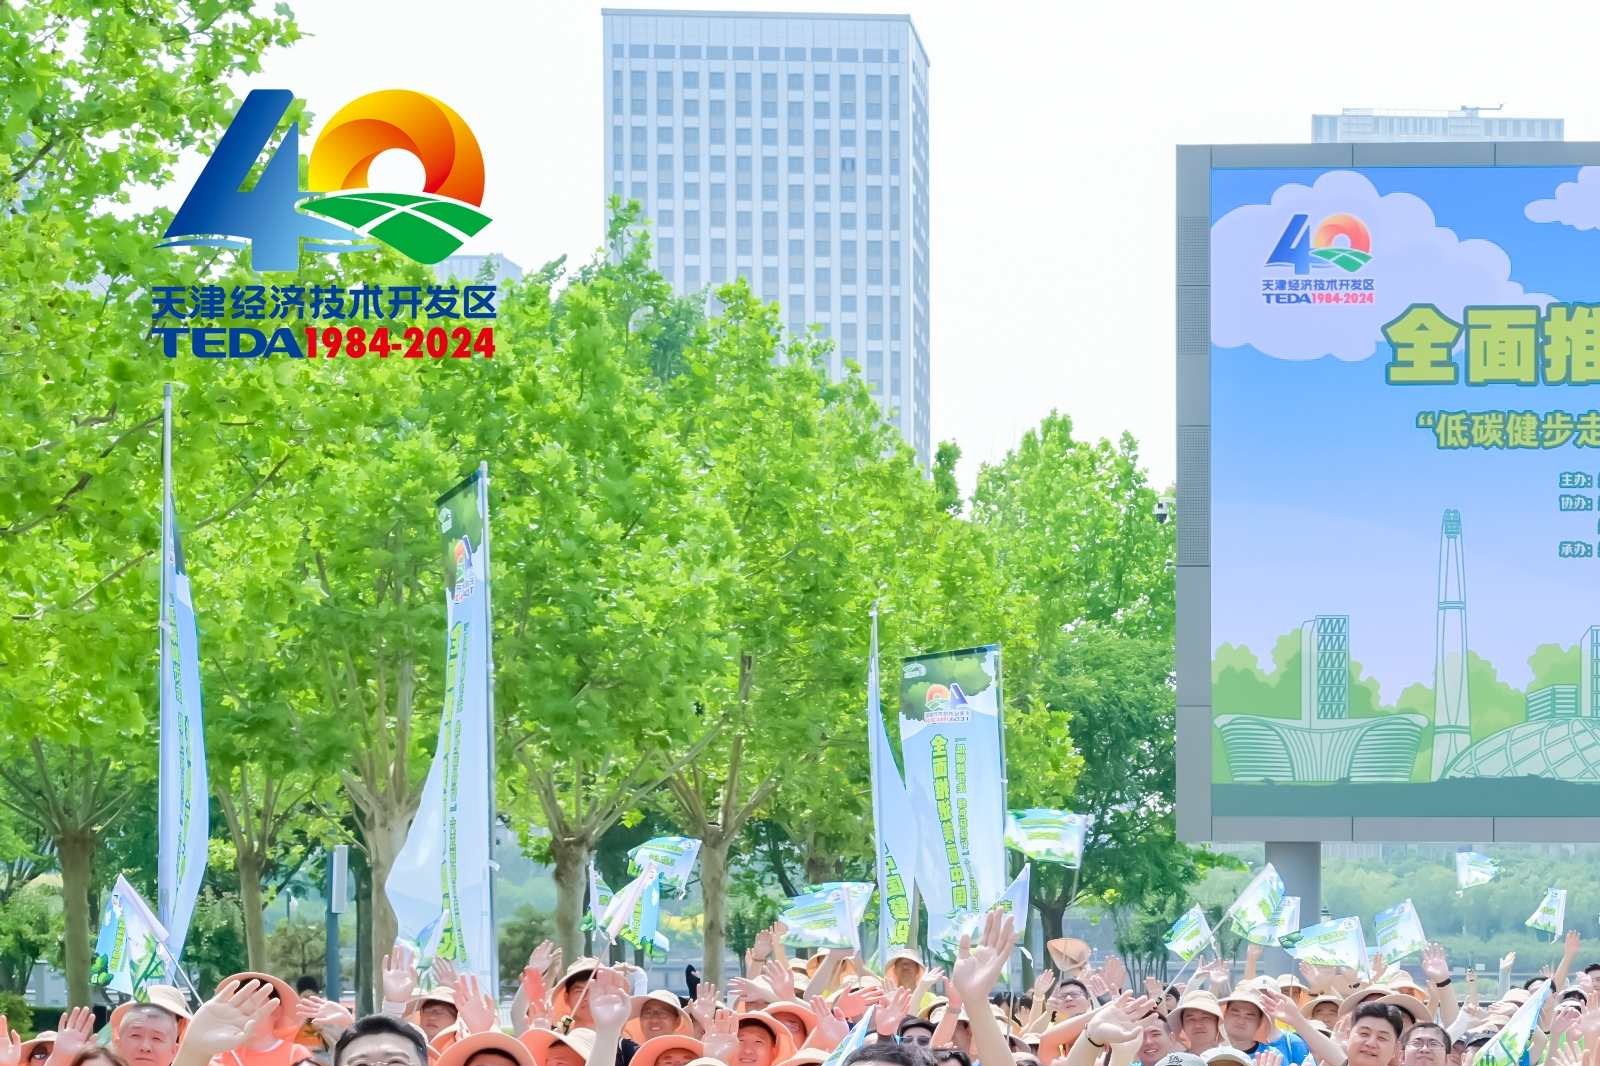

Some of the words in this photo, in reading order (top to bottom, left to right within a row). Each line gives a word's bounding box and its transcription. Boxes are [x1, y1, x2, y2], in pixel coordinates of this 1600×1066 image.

[1262, 279, 1375, 291] 天津经济技术开发区
